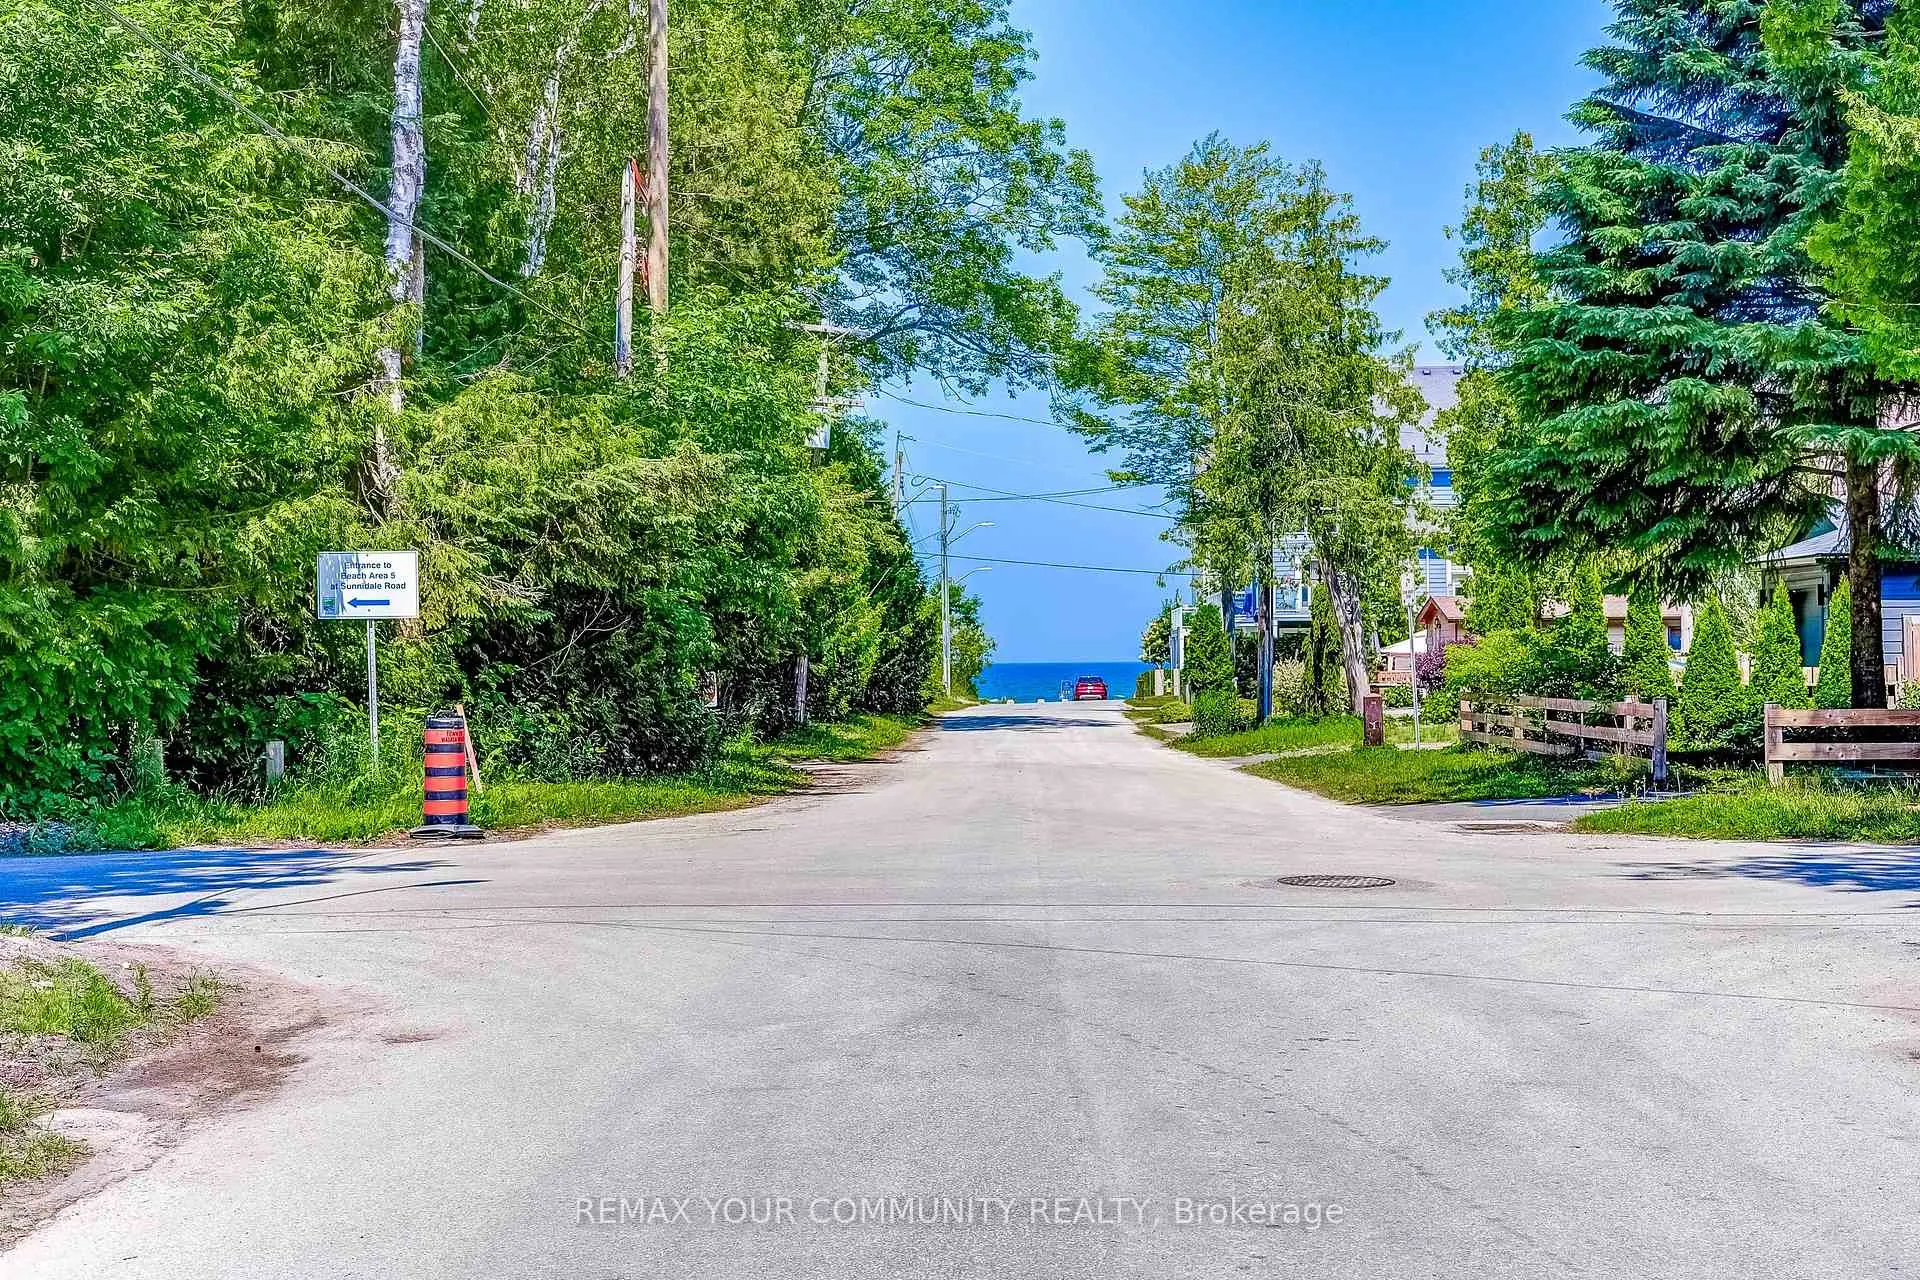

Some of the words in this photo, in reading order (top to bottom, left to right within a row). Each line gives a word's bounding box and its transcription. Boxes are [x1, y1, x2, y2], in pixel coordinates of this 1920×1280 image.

[344, 561, 381, 569] Entrance
[383, 561, 392, 569] to
[341, 572, 367, 580] Beach
[368, 572, 389, 580] Area
[340, 582, 382, 590] Sunnidale
[384, 582, 406, 590] Road
